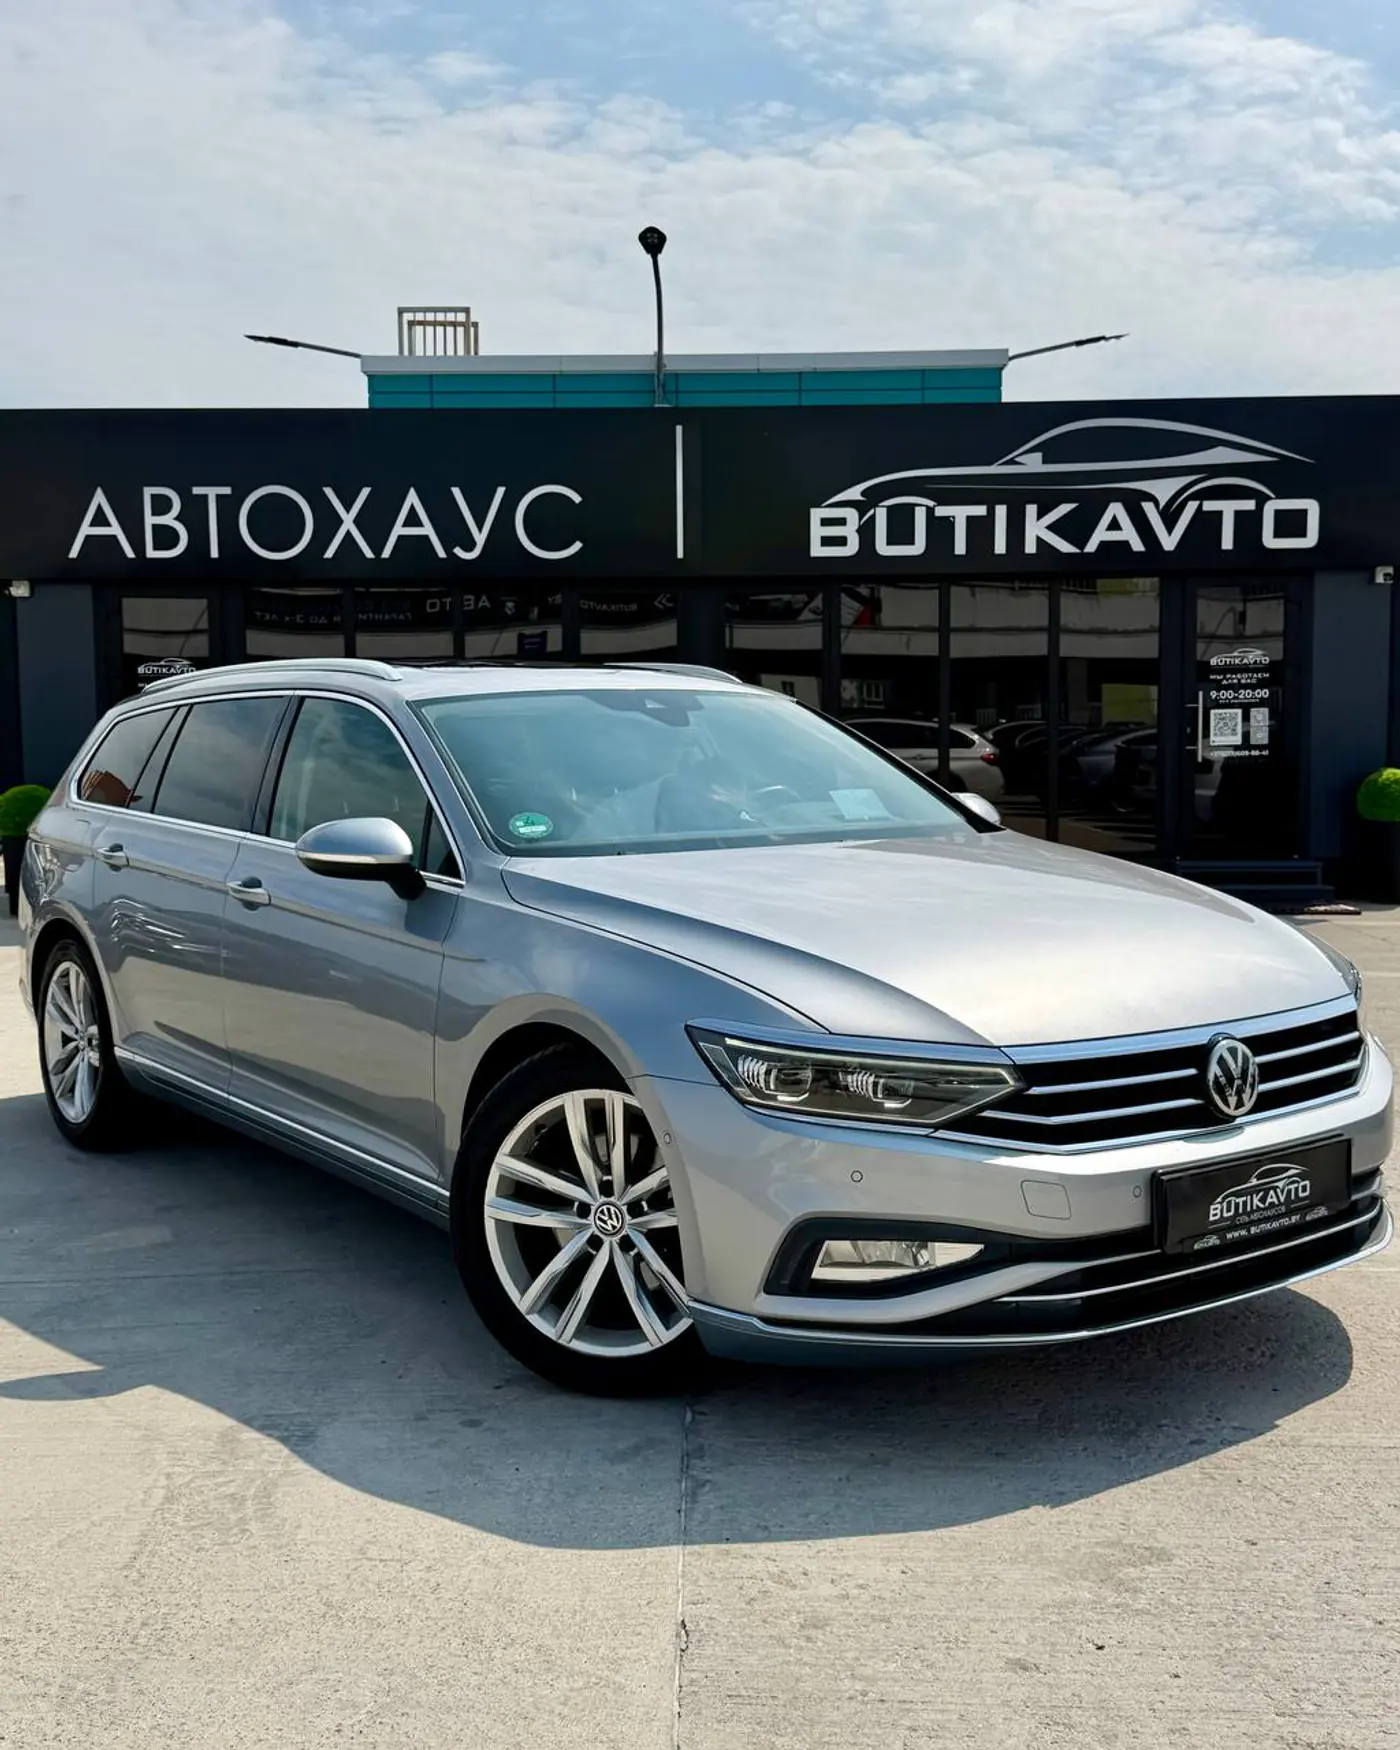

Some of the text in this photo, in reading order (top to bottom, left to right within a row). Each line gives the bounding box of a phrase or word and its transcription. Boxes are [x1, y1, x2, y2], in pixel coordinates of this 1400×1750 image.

[67, 483, 584, 561] АВТОХАУС
[809, 497, 1320, 558] BUTIKAVTO
[1209, 657, 1270, 665] BUTIKAVTO
[1210, 688, 1269, 700] 9:00-20:00
[1208, 1179, 1310, 1222] BUTIKAVTO
